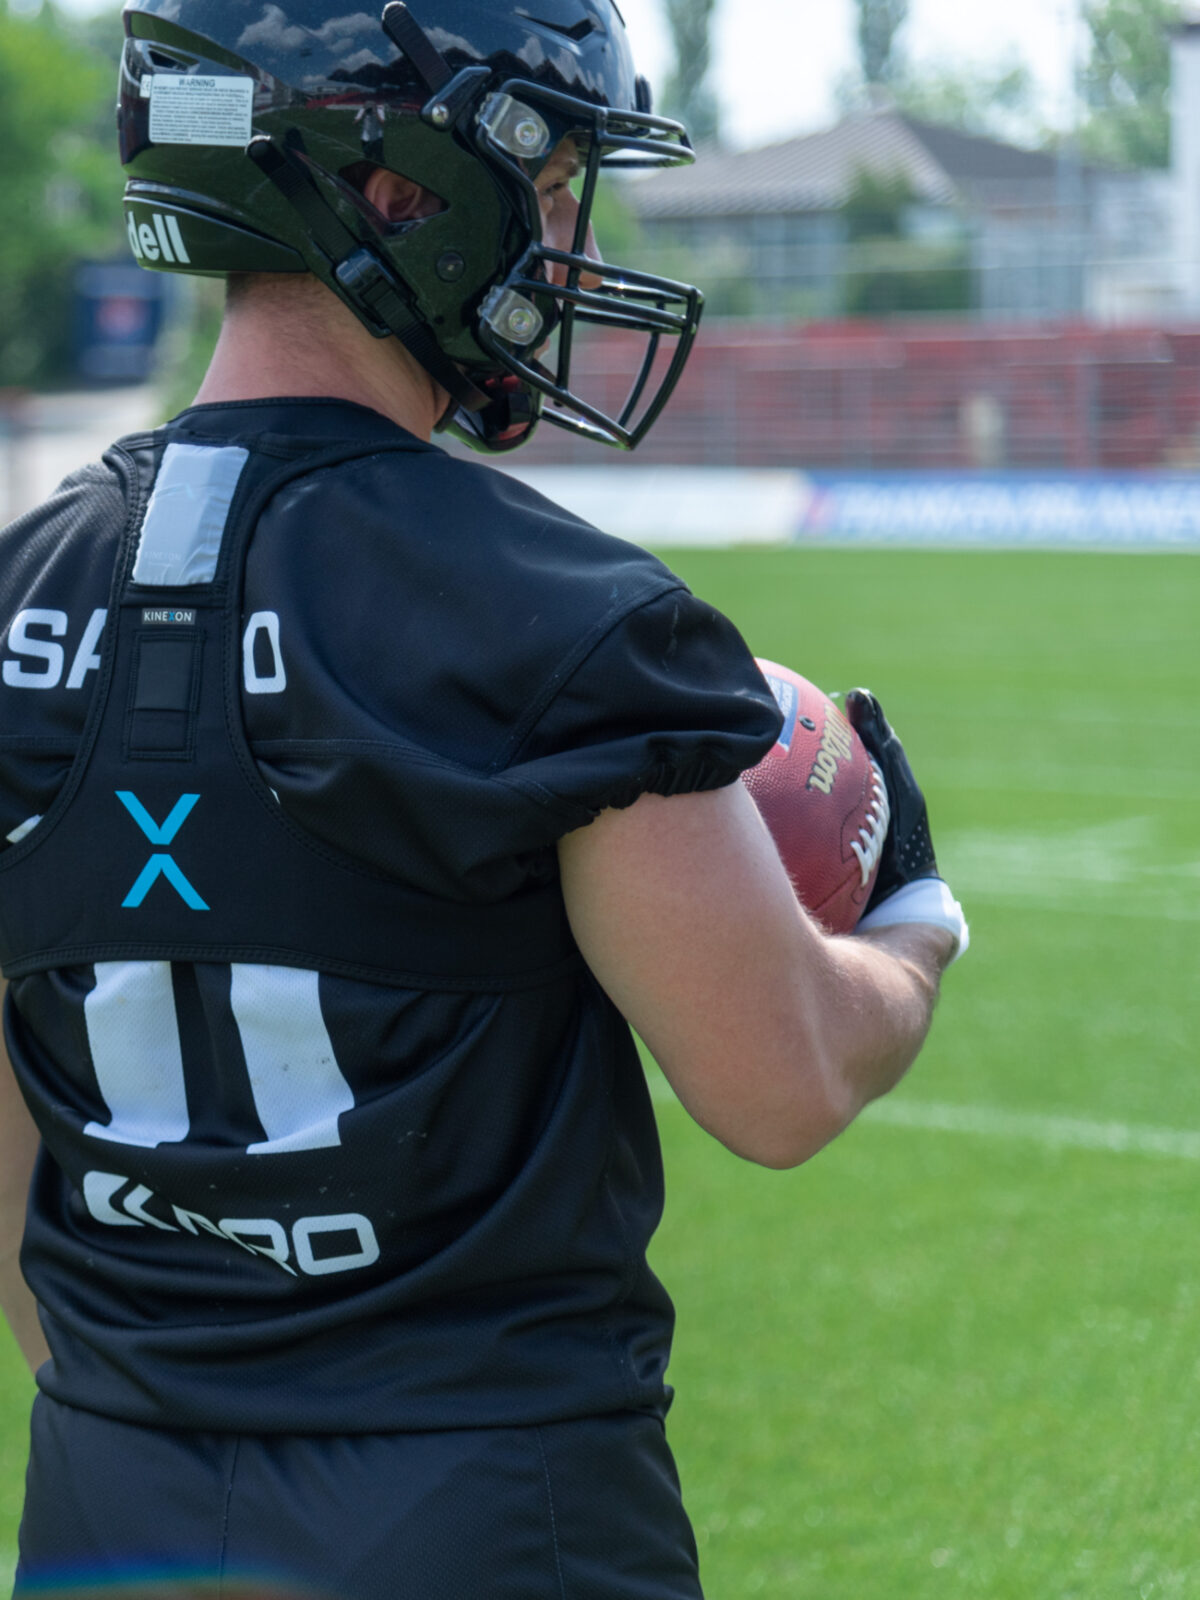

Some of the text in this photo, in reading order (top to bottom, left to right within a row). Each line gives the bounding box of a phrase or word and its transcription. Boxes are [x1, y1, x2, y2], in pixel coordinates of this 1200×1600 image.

[178, 78, 216, 87] WARNING
[144, 611, 192, 622] KINEXON
[807, 703, 853, 796] Wilson
